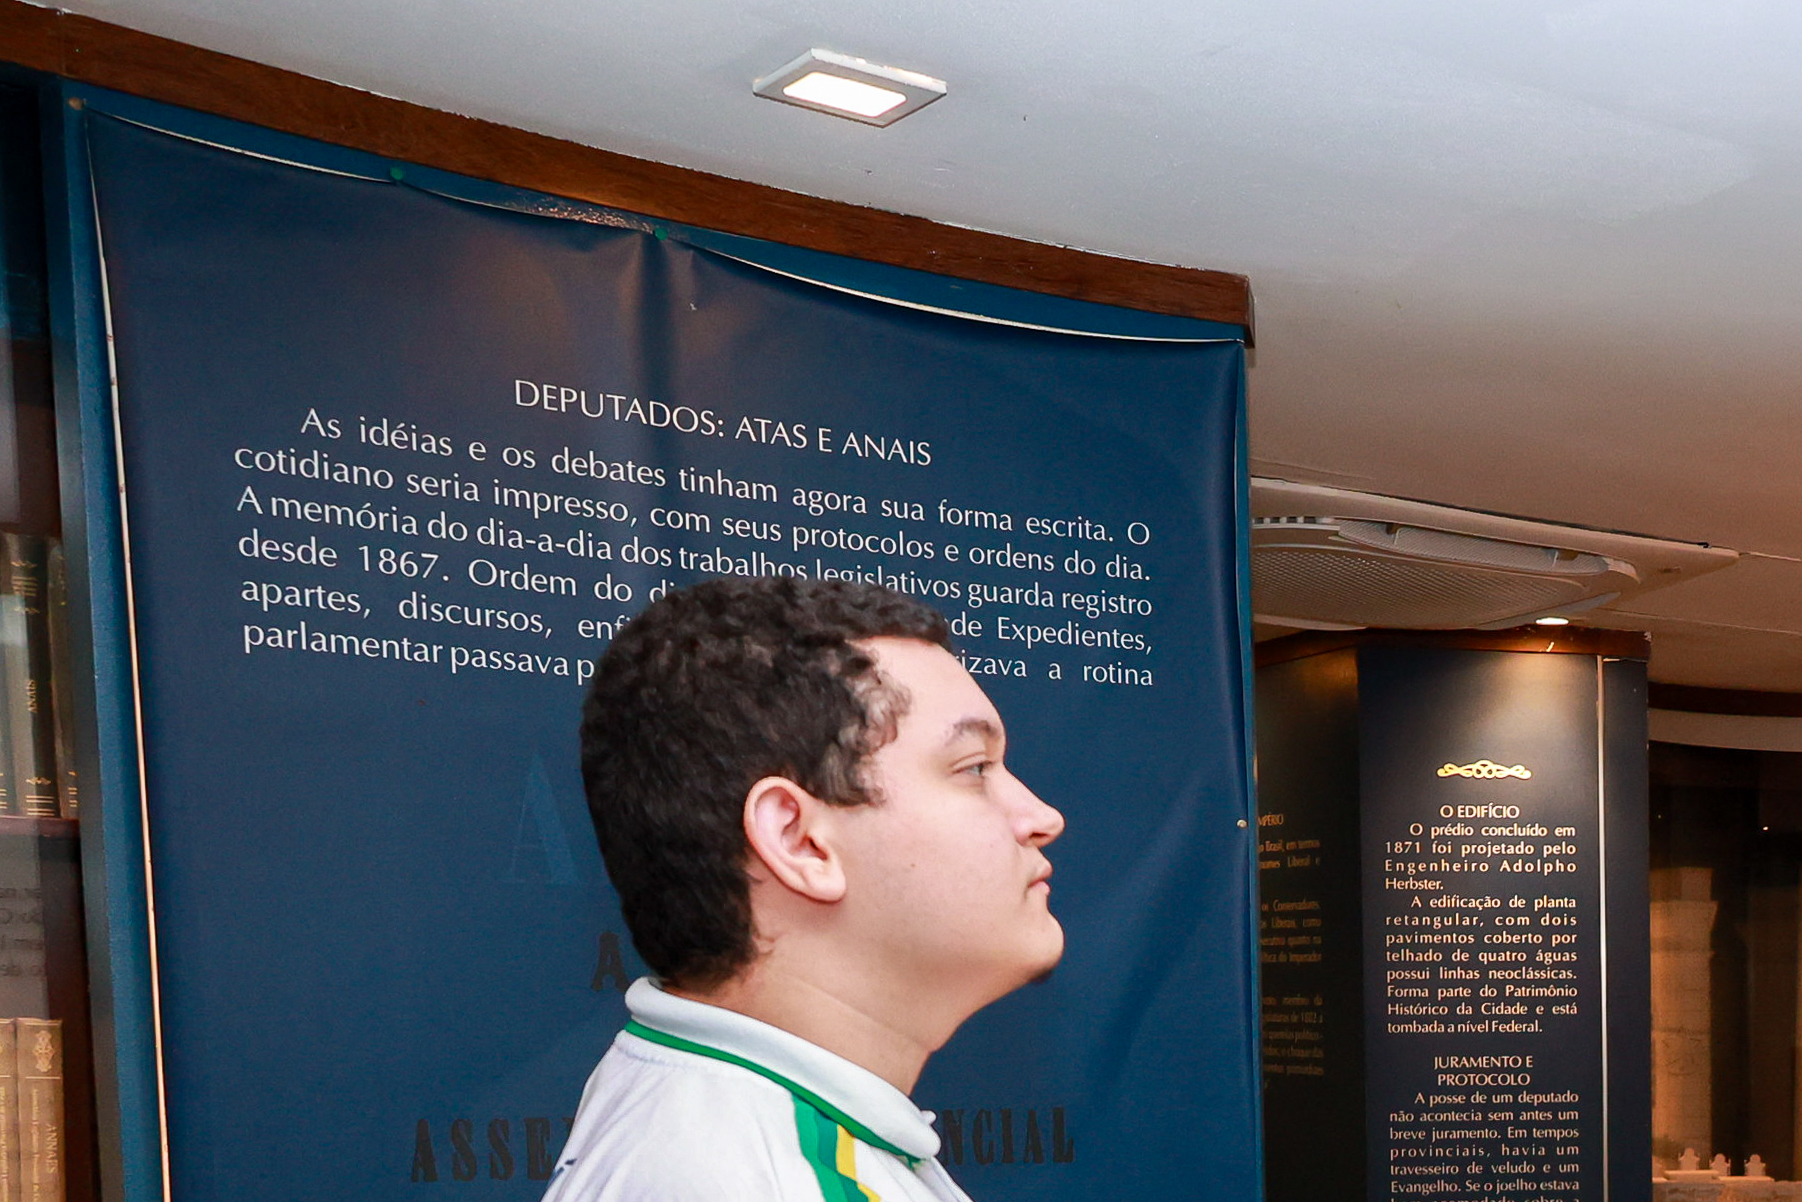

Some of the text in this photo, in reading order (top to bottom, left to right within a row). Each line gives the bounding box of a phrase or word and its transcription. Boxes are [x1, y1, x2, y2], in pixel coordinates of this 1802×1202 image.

[515, 379, 931, 466] DEPUTADOS: ATAS E ANAIS
[300, 408, 1150, 545] As idéias e os debates tinham agora sua forma escrita. O
[234, 448, 1150, 581] cotidiano seria impresso, com seus protocolos e ordens do dia.
[238, 528, 337, 567] desde
[358, 545, 449, 581] 1867.
[468, 559, 576, 596] Ordem
[594, 573, 633, 602] do
[241, 581, 370, 619] apartes,
[398, 591, 552, 639] discursos,
[951, 611, 1152, 655] de Expedientes,
[243, 621, 443, 663] parlamentar
[451, 646, 570, 676] passava
[956, 649, 1153, 686] izava a rotina
[1440, 802, 1520, 818] O EDIFÍCIO
[1409, 822, 1576, 839] O prédio concluído em
[1385, 840, 1576, 858] 1871 foi projetado pelo
[1385, 858, 1576, 876] Engenheiro Adolpho
[1385, 876, 1444, 890] Herbster.
[1411, 894, 1576, 912] A edificação de planta
[1386, 912, 1577, 930] retangular, com dois
[1386, 930, 1577, 947] pavimentos coberto por
[1386, 948, 1577, 965] telhado de quatro águas
[1387, 984, 1578, 1001] Forma parte do Patrimônio
[1388, 1001, 1577, 1015] Histórico da Cidade e está
[1434, 1055, 1533, 1070] JURAMENTO E
[1438, 1073, 1531, 1086] PROTOCOLO
[941, 1106, 1075, 1166] NCIAL
